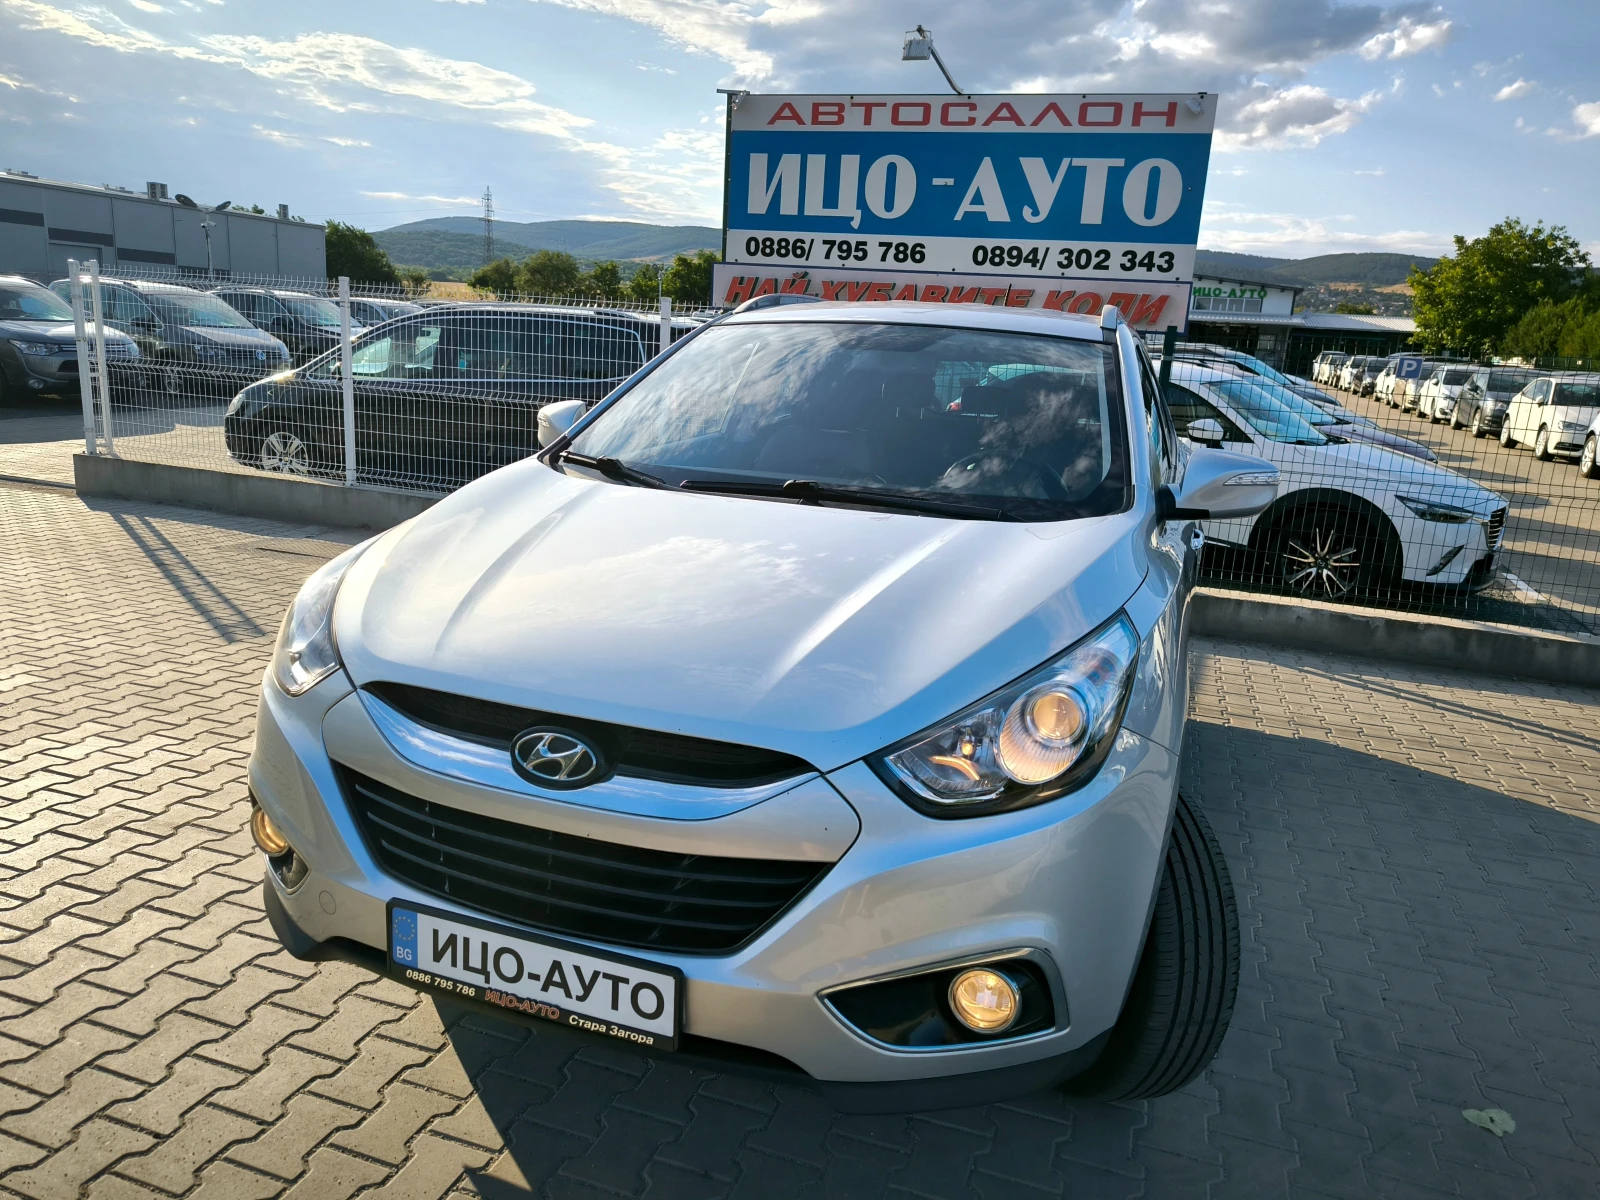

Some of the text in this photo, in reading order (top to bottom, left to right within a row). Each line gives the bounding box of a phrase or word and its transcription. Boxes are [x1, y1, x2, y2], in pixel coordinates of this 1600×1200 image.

[767, 101, 1178, 127] АВТОСАЛОН
[745, 236, 1175, 273] 0886/ 795 786 0894/ 302 343
[1192, 286, 1268, 299] ИЦО-АУТО
[1400, 359, 1418, 377] P
[396, 945, 412, 961] BG
[432, 928, 665, 1021] ИЦО-АУТО
[405, 969, 654, 1045] 0886 795 786 ИЦО-АУТО Стара Загора
